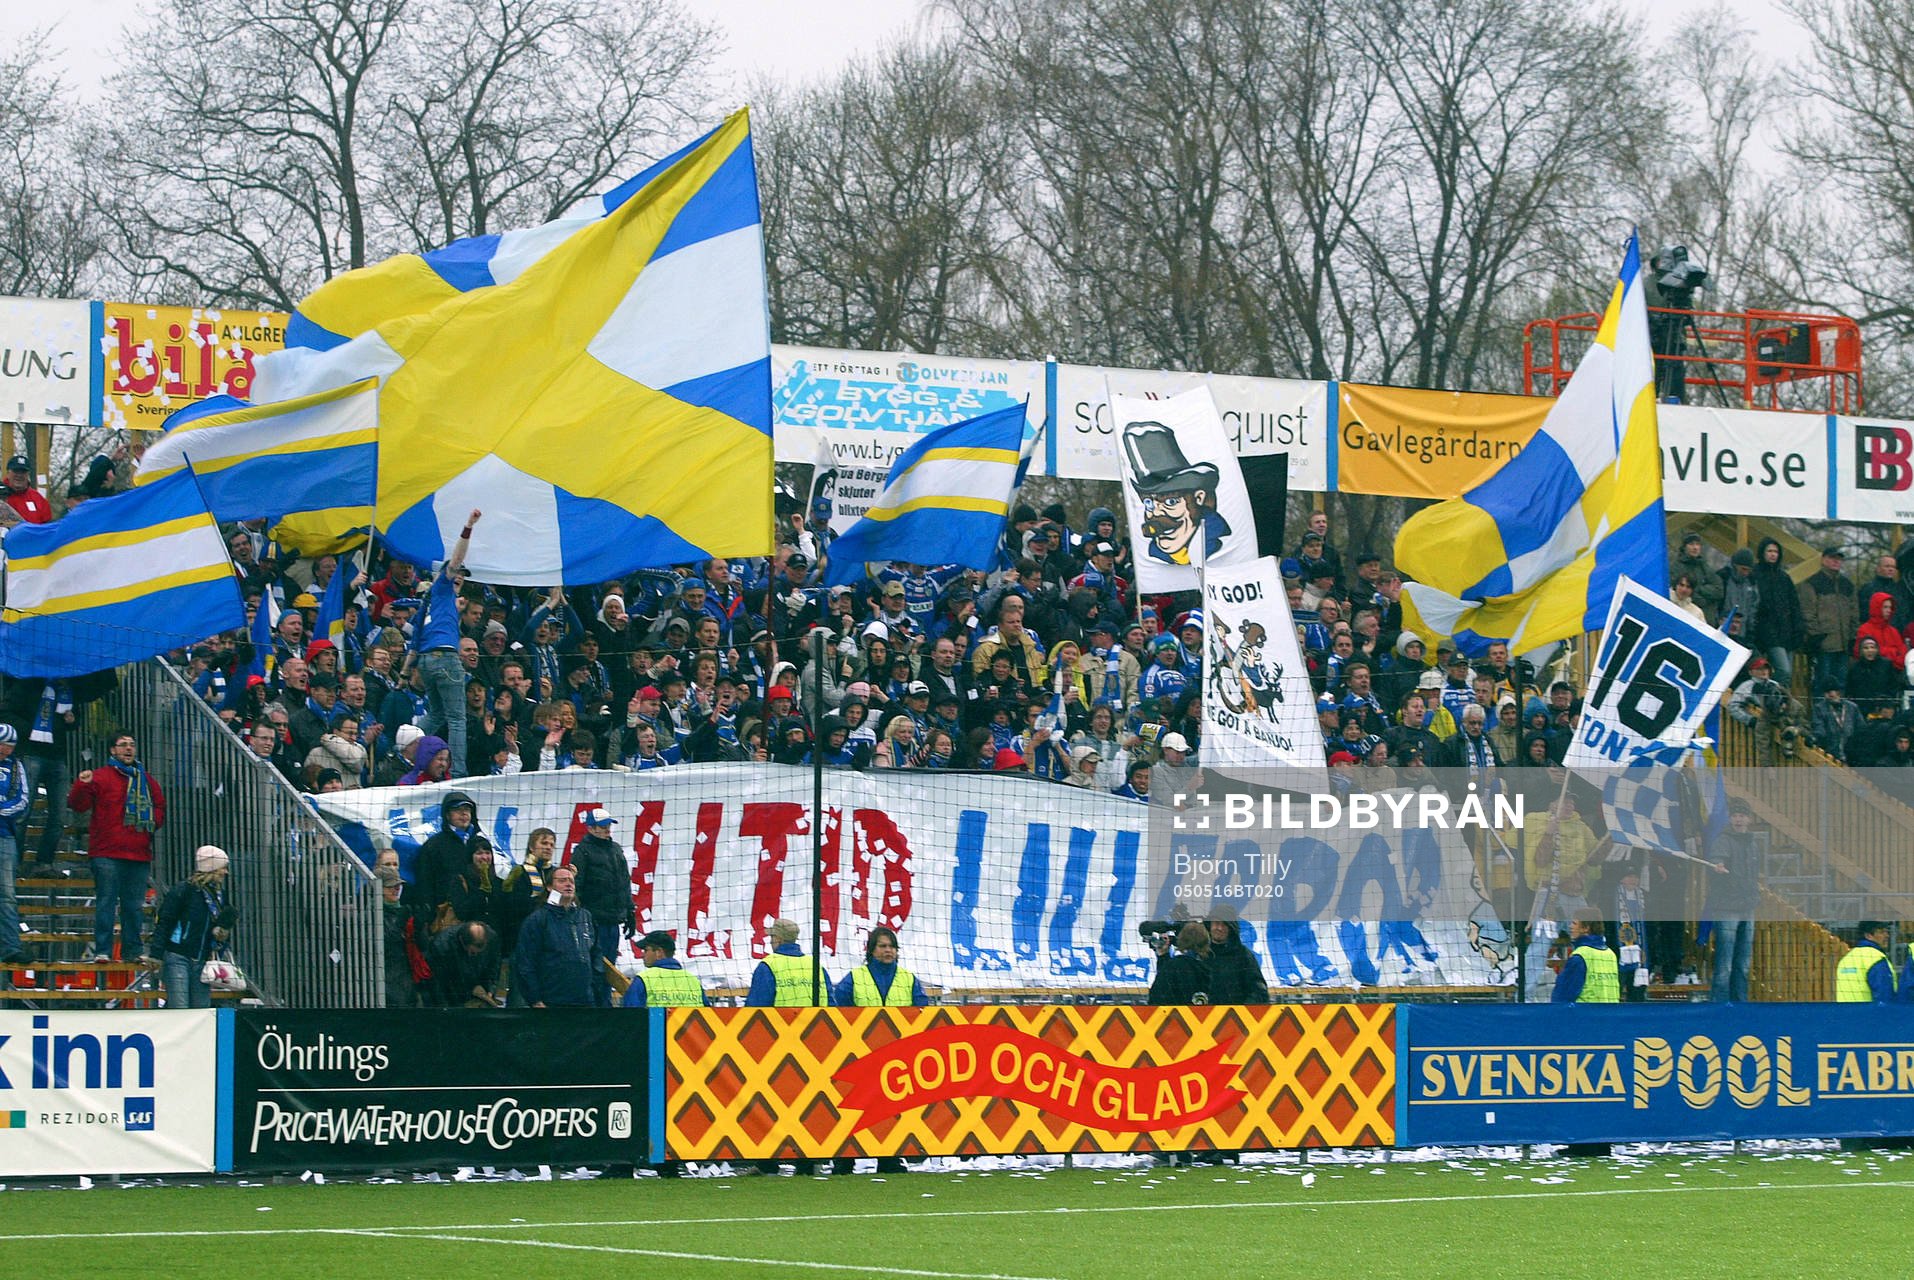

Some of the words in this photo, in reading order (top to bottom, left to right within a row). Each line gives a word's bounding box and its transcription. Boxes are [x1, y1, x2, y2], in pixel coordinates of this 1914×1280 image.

[834, 362, 881, 376] FÖRTAG
[1221, 580, 1264, 604] GOD!
[1590, 613, 1706, 740] 16
[32, 1015, 155, 1089] inn
[257, 1024, 389, 1082] Öhrlings
[879, 1041, 978, 1102] GOD
[990, 1042, 1086, 1107] OCH
[1092, 1071, 1209, 1122] GLAD
[1421, 1052, 1625, 1098] SVENSKA
[1633, 1034, 1811, 1110] POOL
[41, 1112, 119, 1125] REZIDOR
[126, 1111, 153, 1124] SAS
